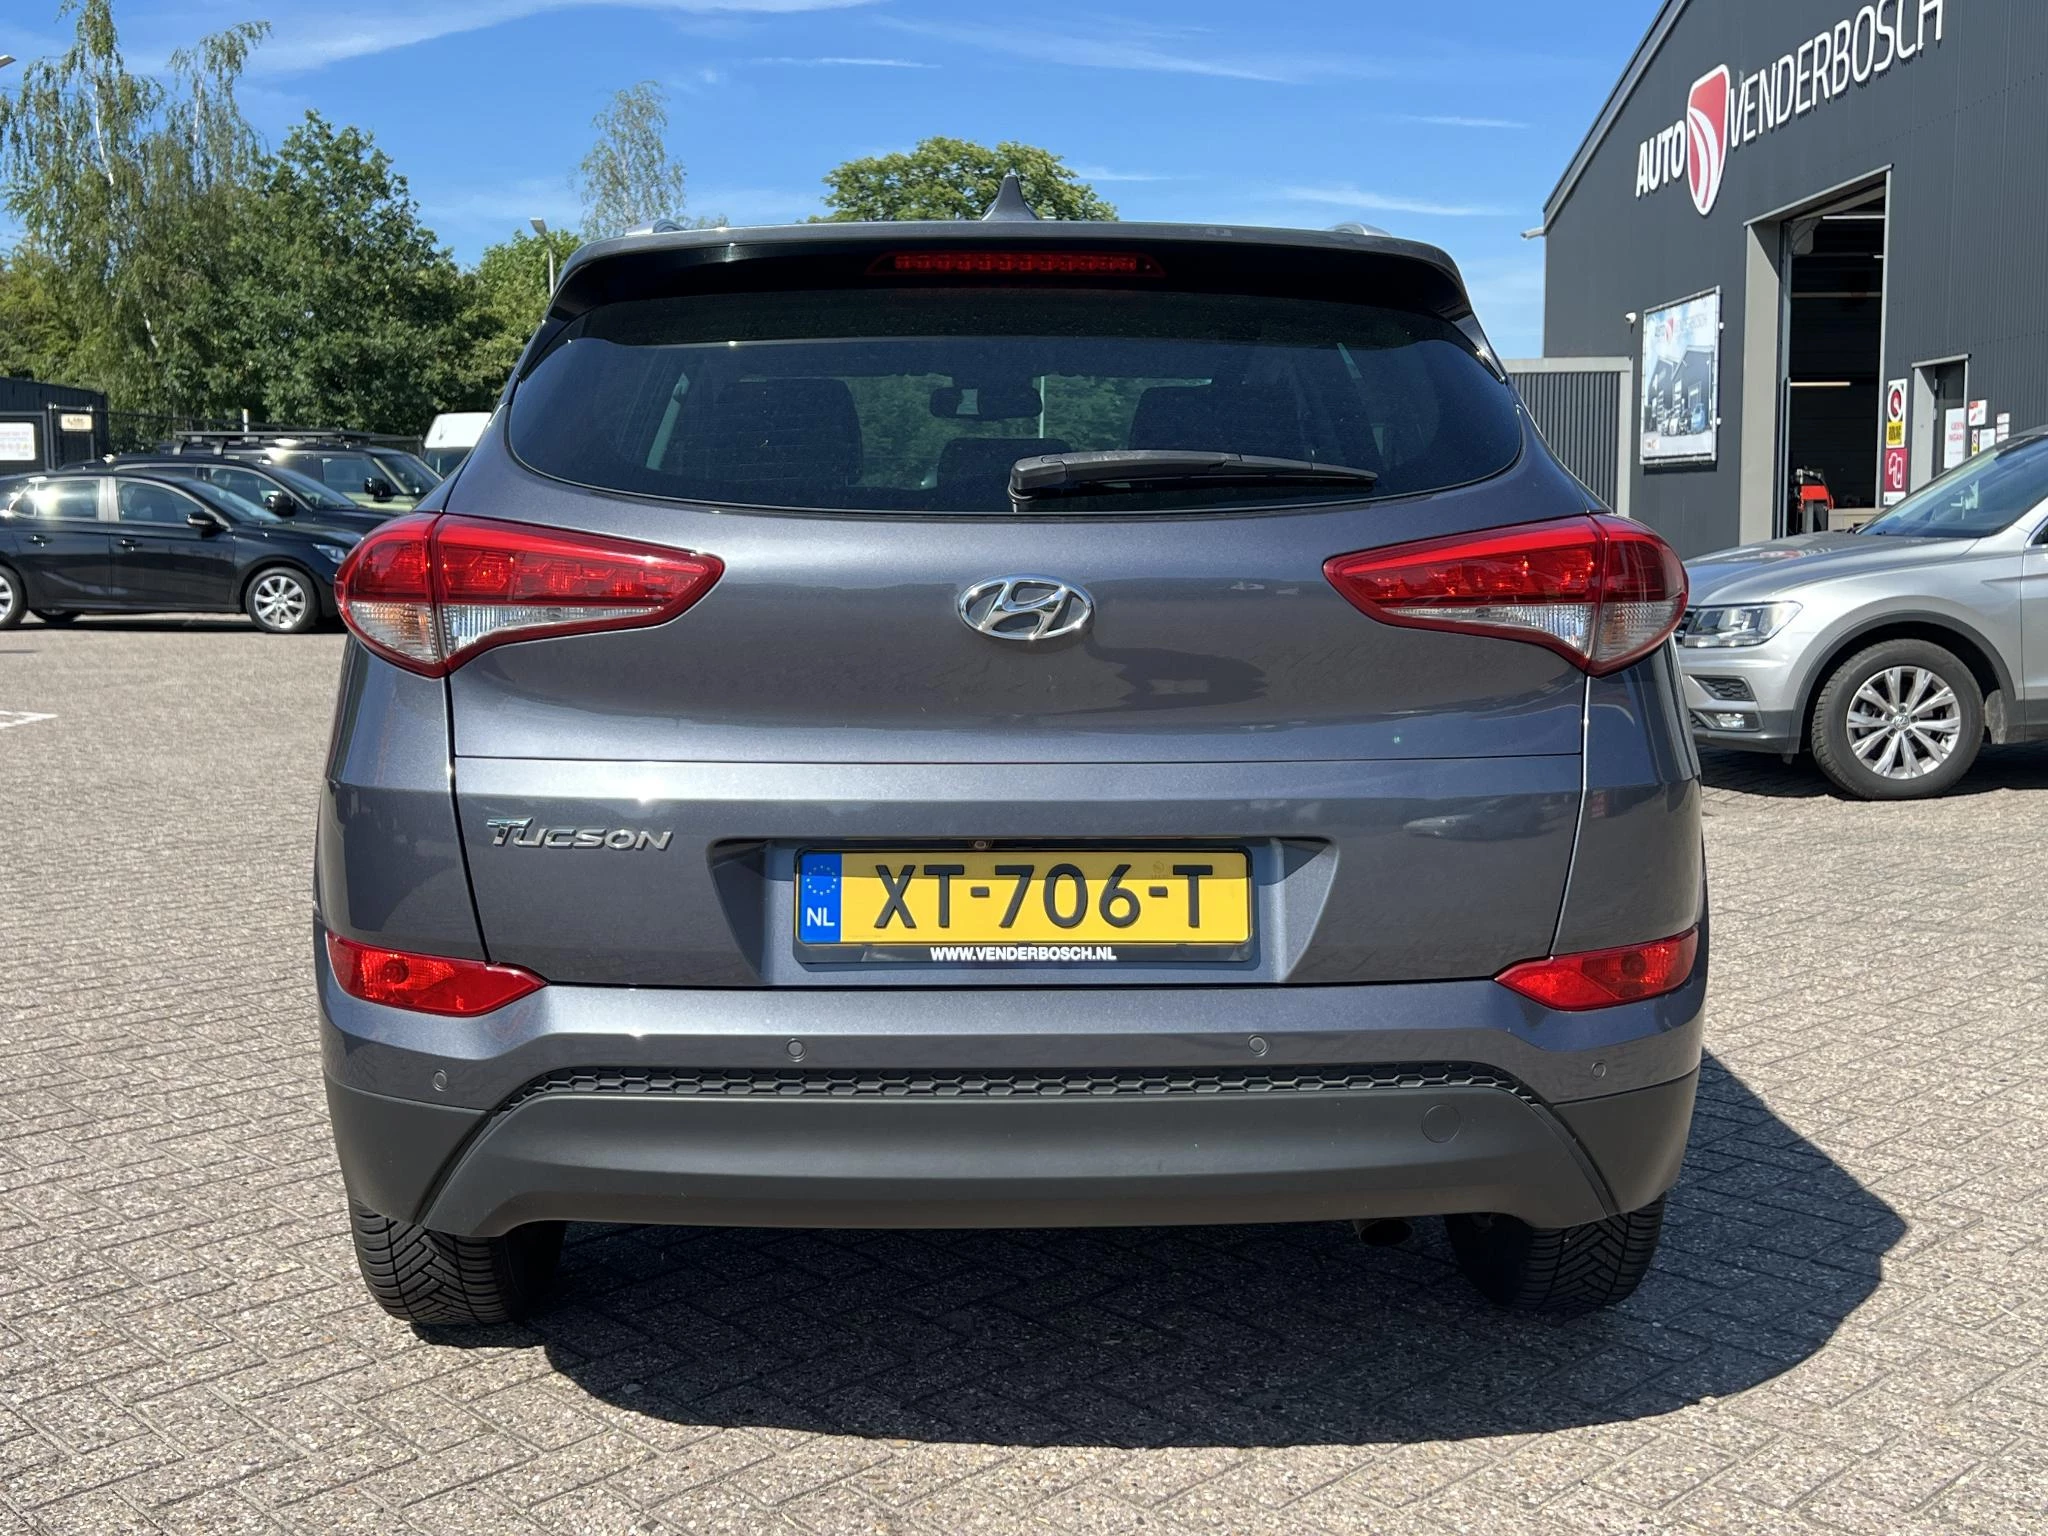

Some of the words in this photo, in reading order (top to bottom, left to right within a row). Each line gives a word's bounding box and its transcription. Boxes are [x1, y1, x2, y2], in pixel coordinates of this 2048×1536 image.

[1636, 120, 1686, 198] AUTO
[487, 817, 674, 850] TUCSON
[873, 864, 1214, 929] XT-706-T
[806, 907, 835, 927] NL
[930, 946, 1117, 961] WWW.VENDERBOSCH.NL
